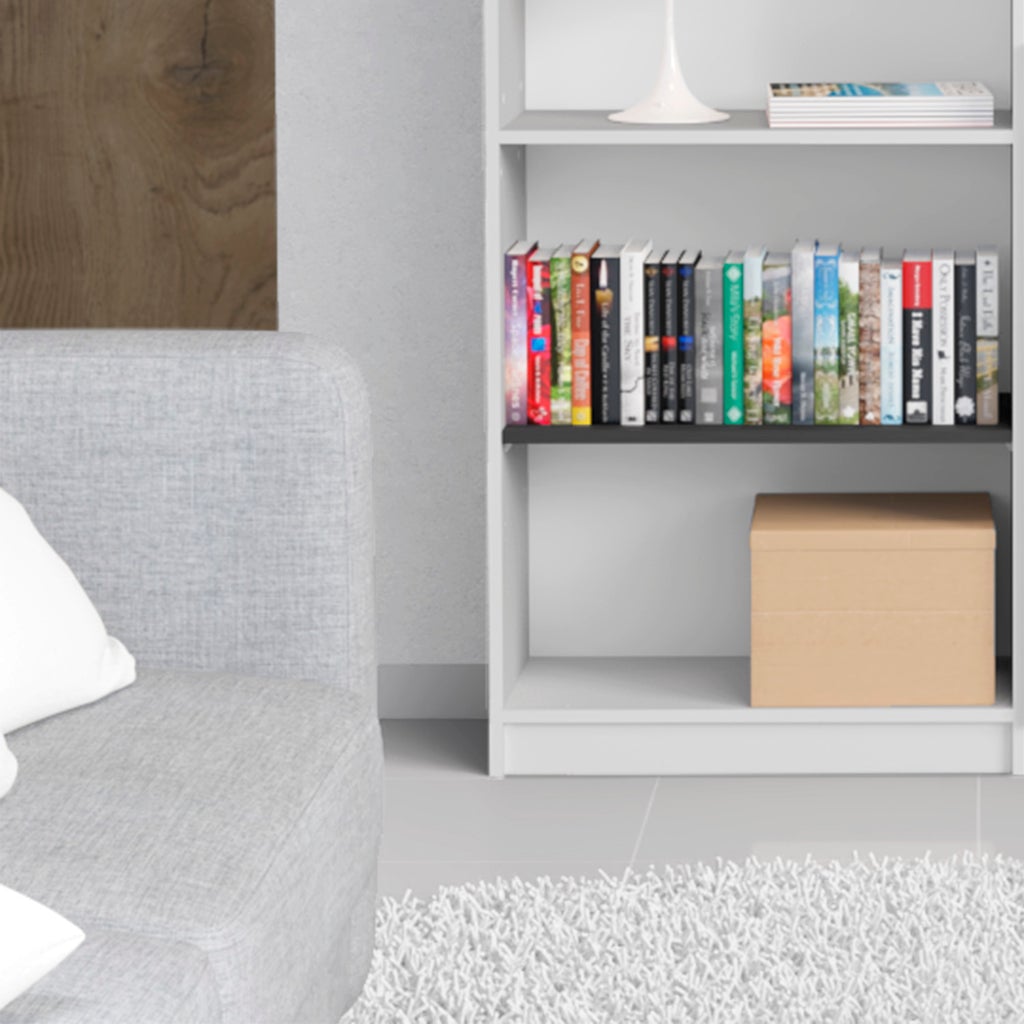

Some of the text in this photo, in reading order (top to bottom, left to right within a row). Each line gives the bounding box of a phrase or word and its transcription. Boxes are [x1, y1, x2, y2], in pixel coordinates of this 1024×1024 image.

[938, 263, 952, 348] ONLY POSSESSION
[600, 330, 610, 344] the
[728, 313, 741, 341] Story
[911, 319, 924, 346] Have
[572, 337, 590, 357] Cup
[600, 345, 610, 373] Candle
[574, 358, 590, 369] of
[573, 370, 590, 401] Coffee
[911, 368, 924, 399] Name
